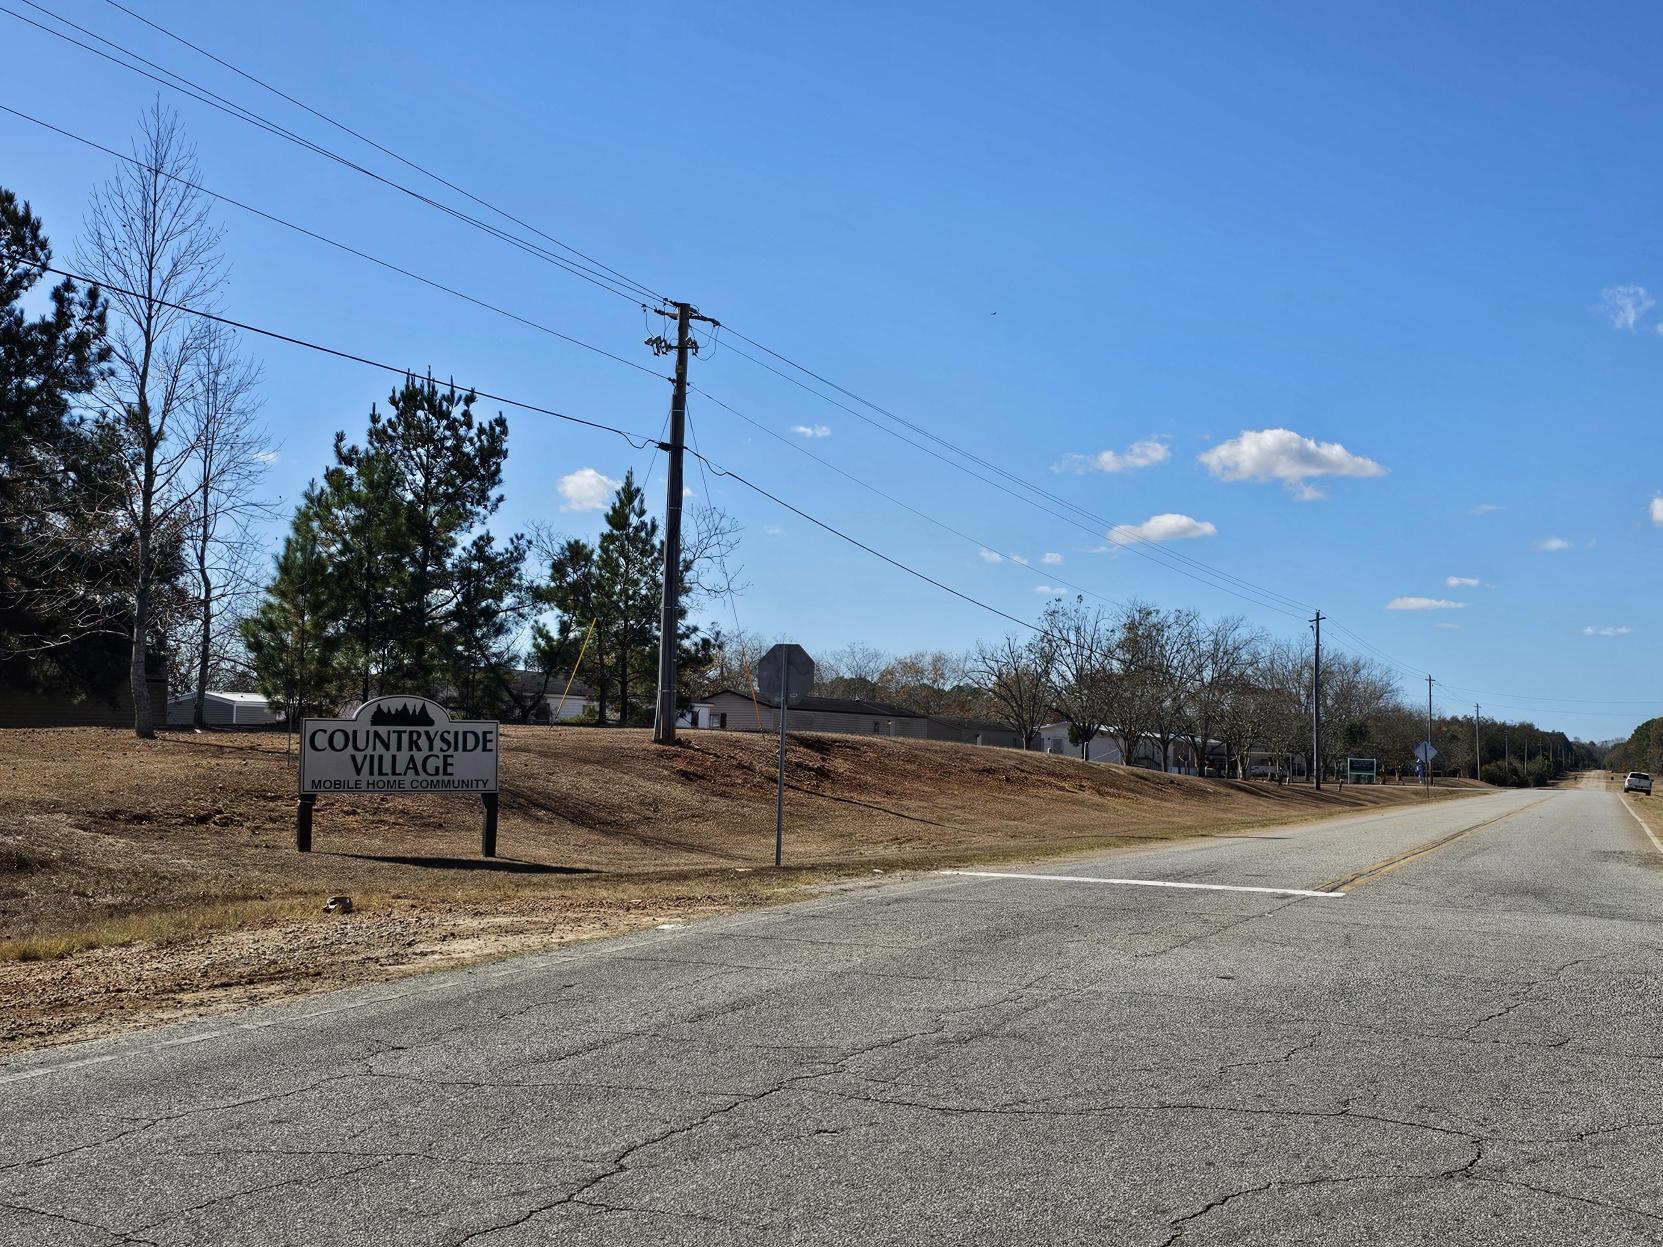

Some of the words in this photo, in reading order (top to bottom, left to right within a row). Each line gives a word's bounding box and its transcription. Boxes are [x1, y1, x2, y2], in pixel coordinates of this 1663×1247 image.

[309, 728, 494, 752] COUNTRYSIDE
[350, 754, 454, 777] VILLAGE
[311, 779, 362, 790] MOBILE
[366, 779, 405, 790] HOME
[410, 779, 489, 789] COMMUNITY
